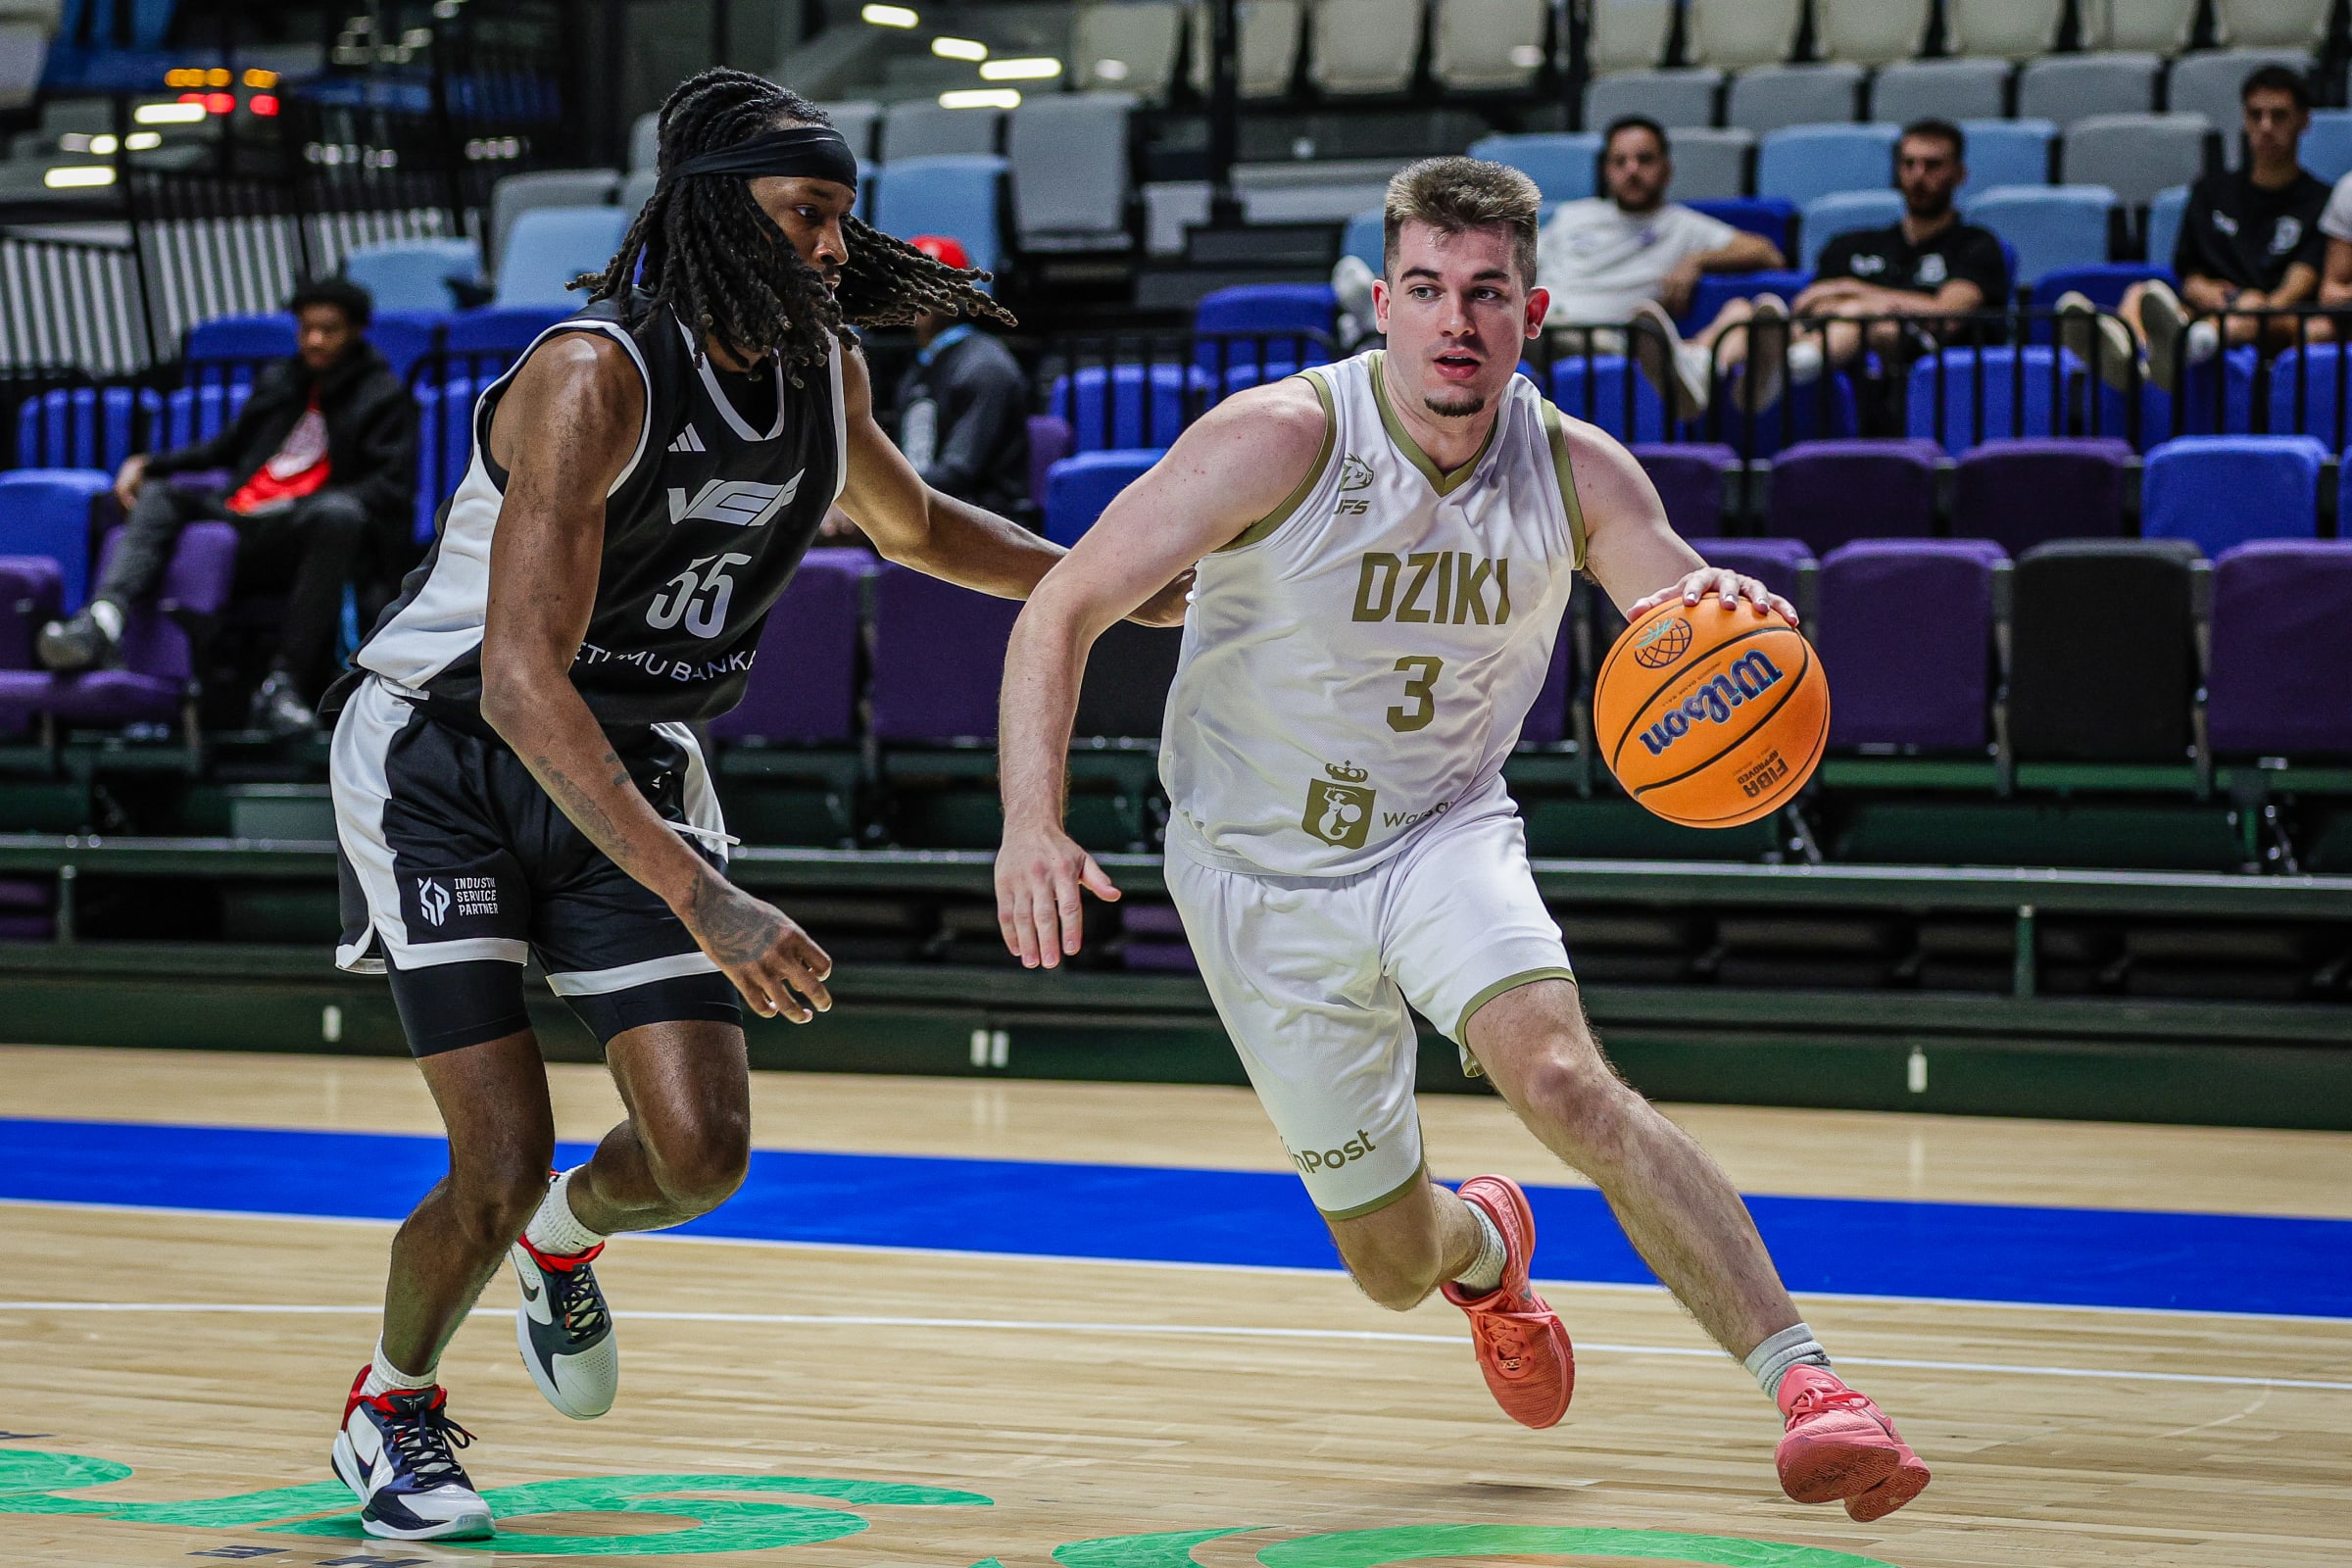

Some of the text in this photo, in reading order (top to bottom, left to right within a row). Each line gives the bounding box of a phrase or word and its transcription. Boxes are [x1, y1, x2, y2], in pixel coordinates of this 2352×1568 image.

[645, 552, 753, 639] 55
[1351, 551, 1511, 625] DZIKI
[1386, 655, 1445, 733] 3
[1639, 648, 1786, 758] Wilson
[1738, 749, 1780, 784] APPROVED
[1742, 757, 1789, 799] FIBA
[456, 889, 497, 903] SERVICE
[458, 903, 499, 916] PARTNER
